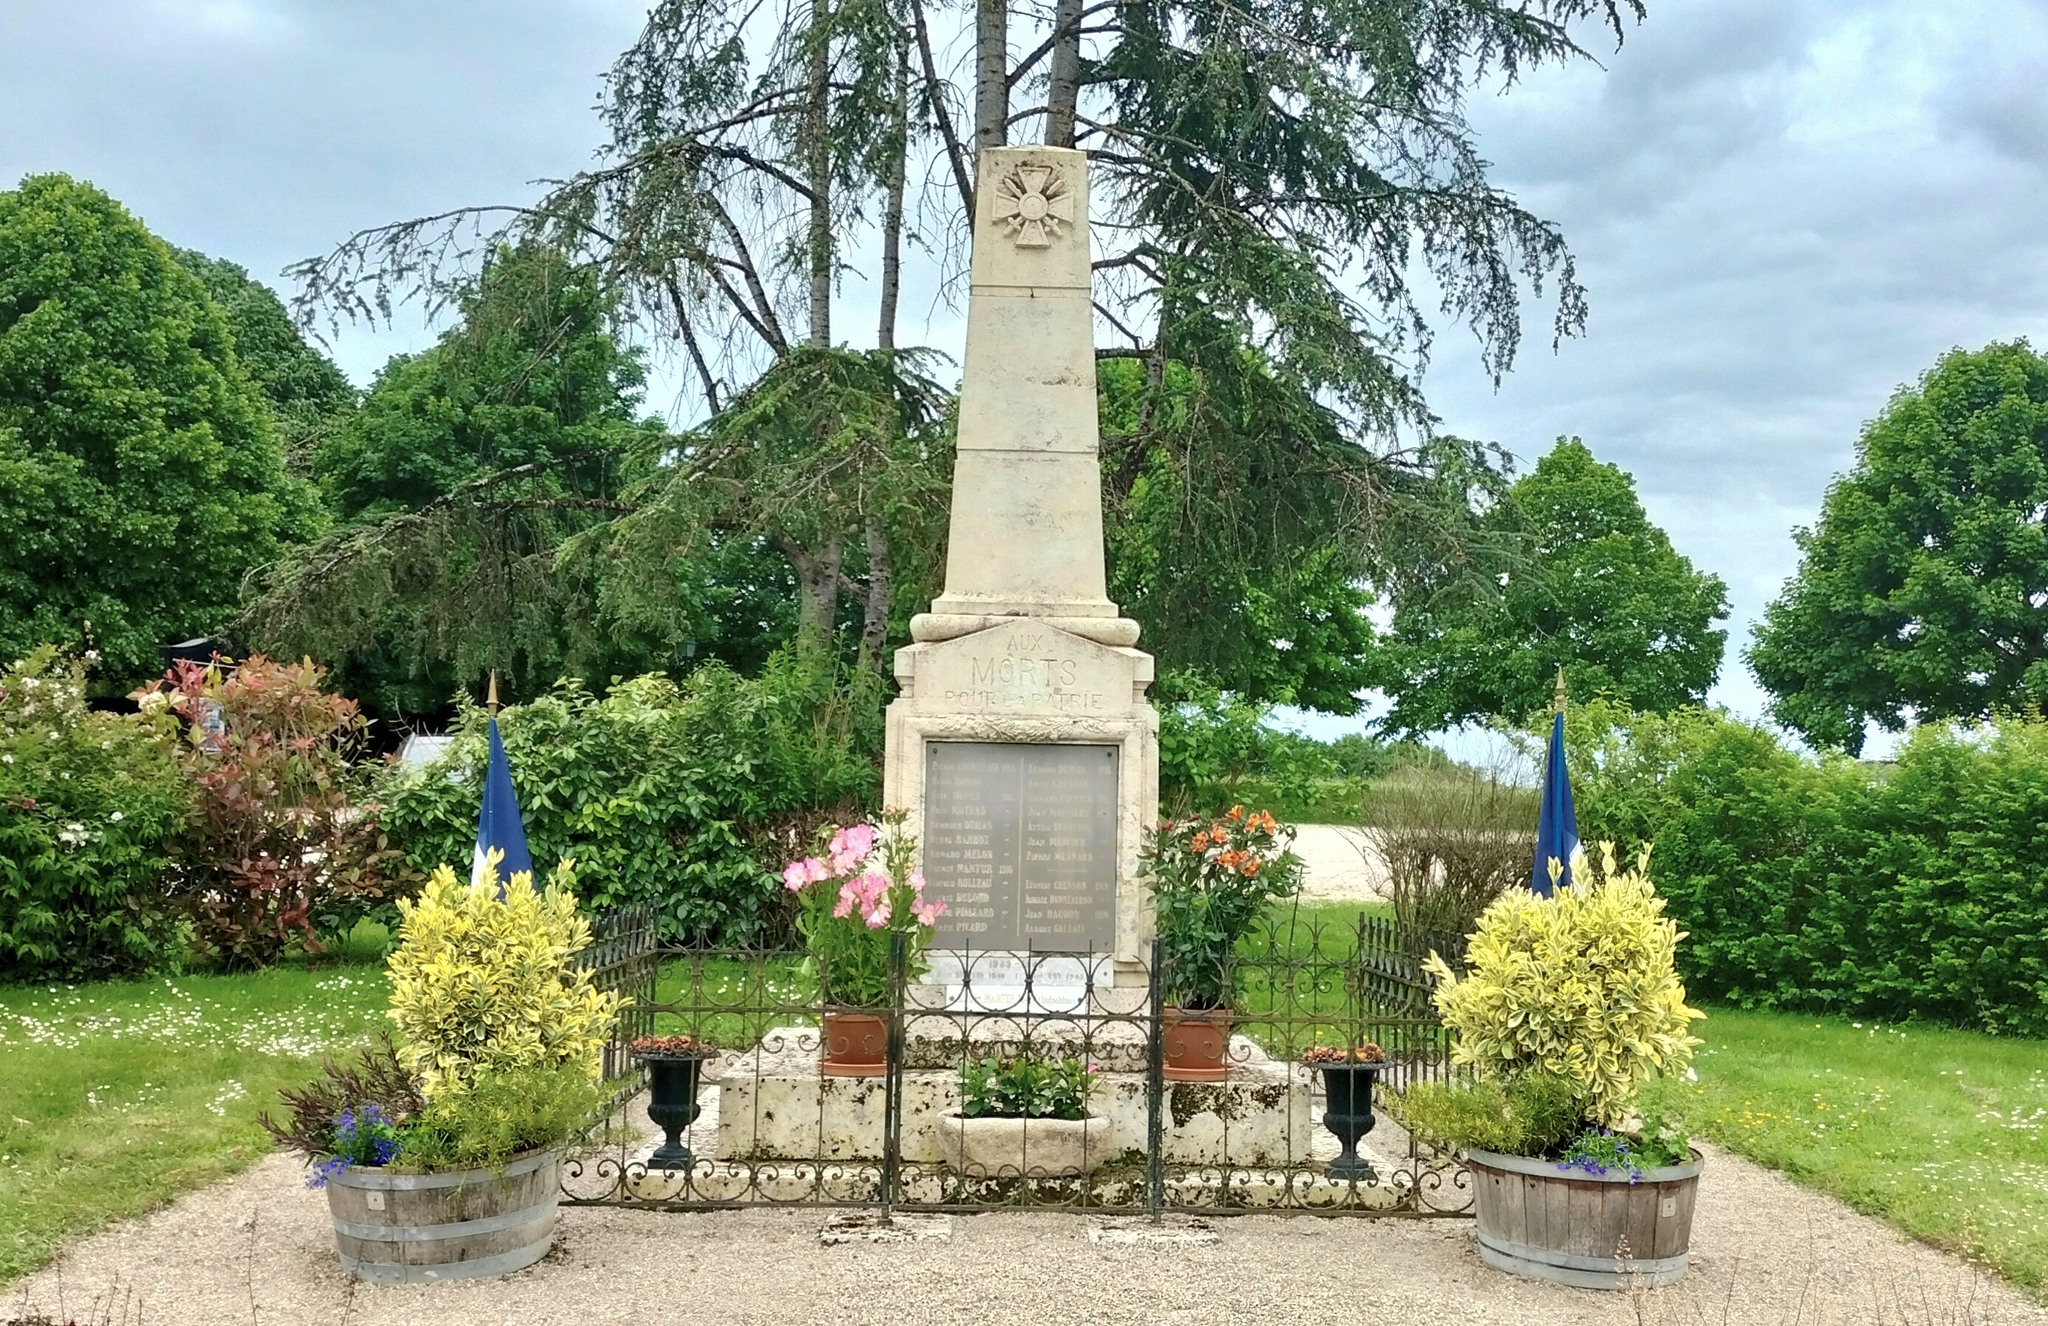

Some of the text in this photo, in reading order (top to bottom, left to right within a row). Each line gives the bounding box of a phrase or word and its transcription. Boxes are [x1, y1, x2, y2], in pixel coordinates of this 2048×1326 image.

[1006, 634, 1043, 651] AUX
[972, 656, 1077, 687] MORTS
[945, 690, 995, 705] POUR
[1032, 691, 1103, 710] PATRIE
